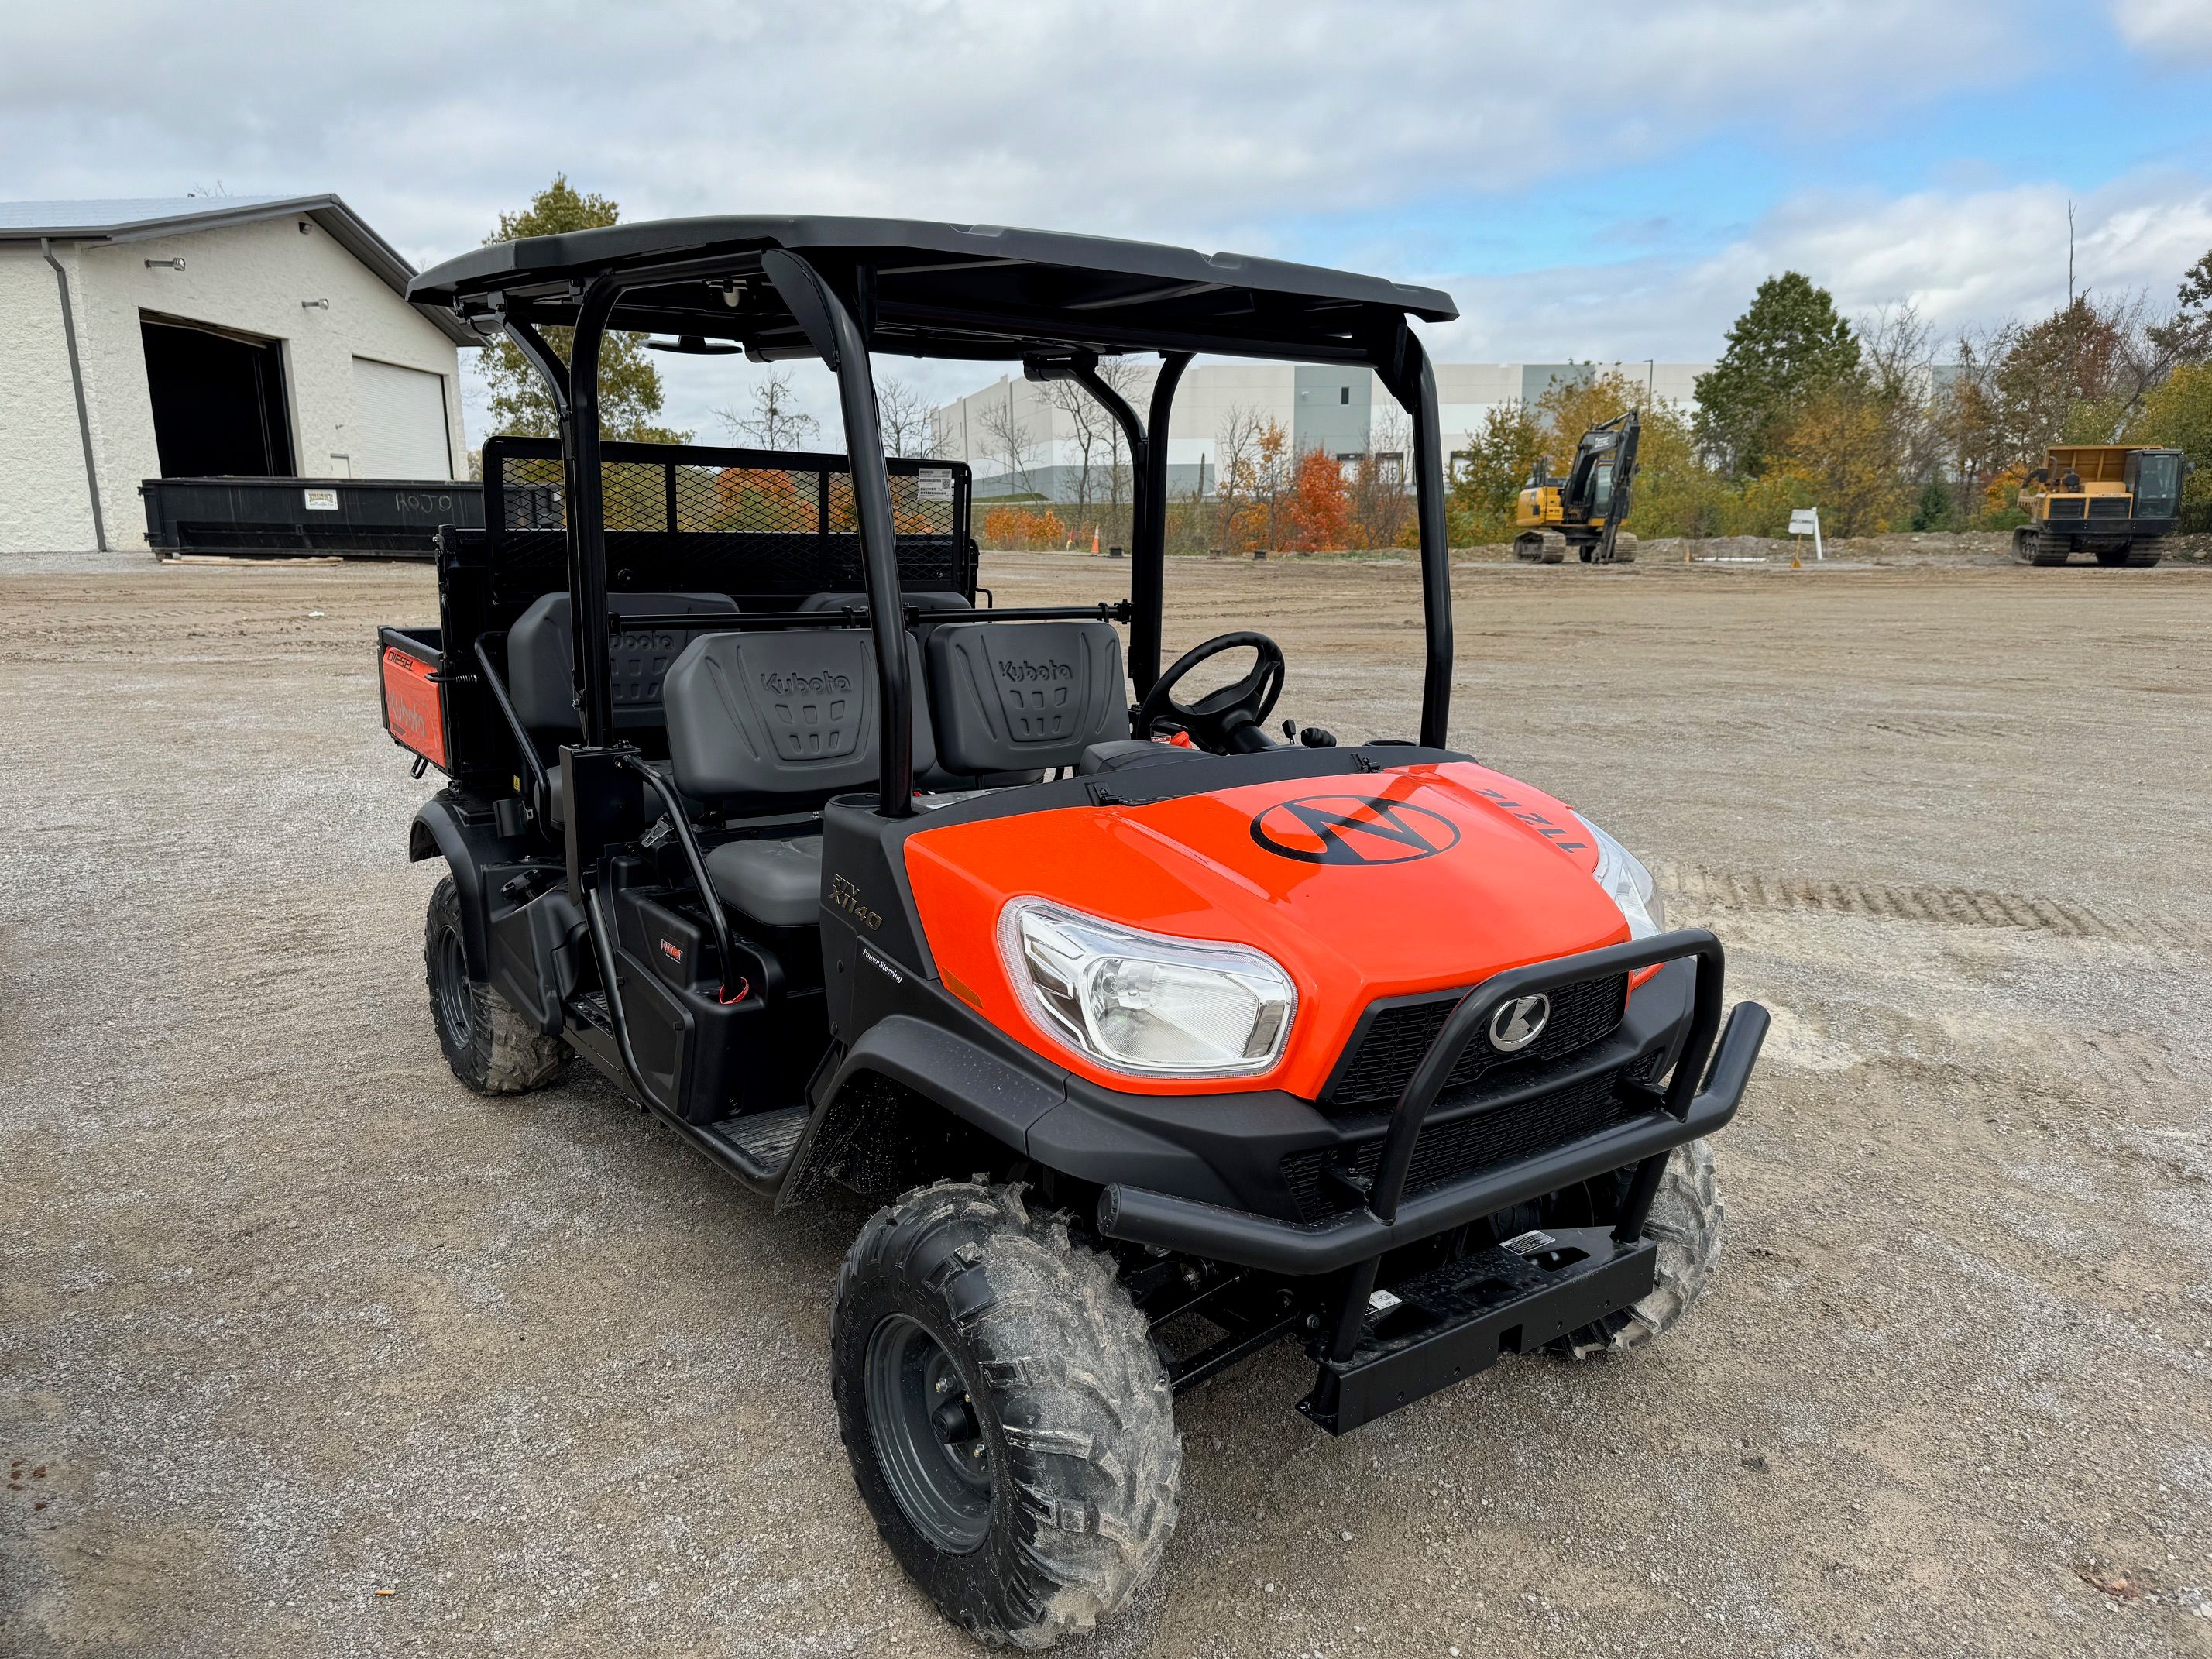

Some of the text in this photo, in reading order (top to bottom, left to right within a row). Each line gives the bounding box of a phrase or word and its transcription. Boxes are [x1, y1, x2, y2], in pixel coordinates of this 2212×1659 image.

[610, 631, 673, 650] ubota
[388, 651, 414, 672] DIESEL
[998, 660, 1073, 682] Kubota
[760, 671, 851, 694] Kubota
[833, 873, 860, 897] RTV
[862, 948, 904, 984] Power Steering
